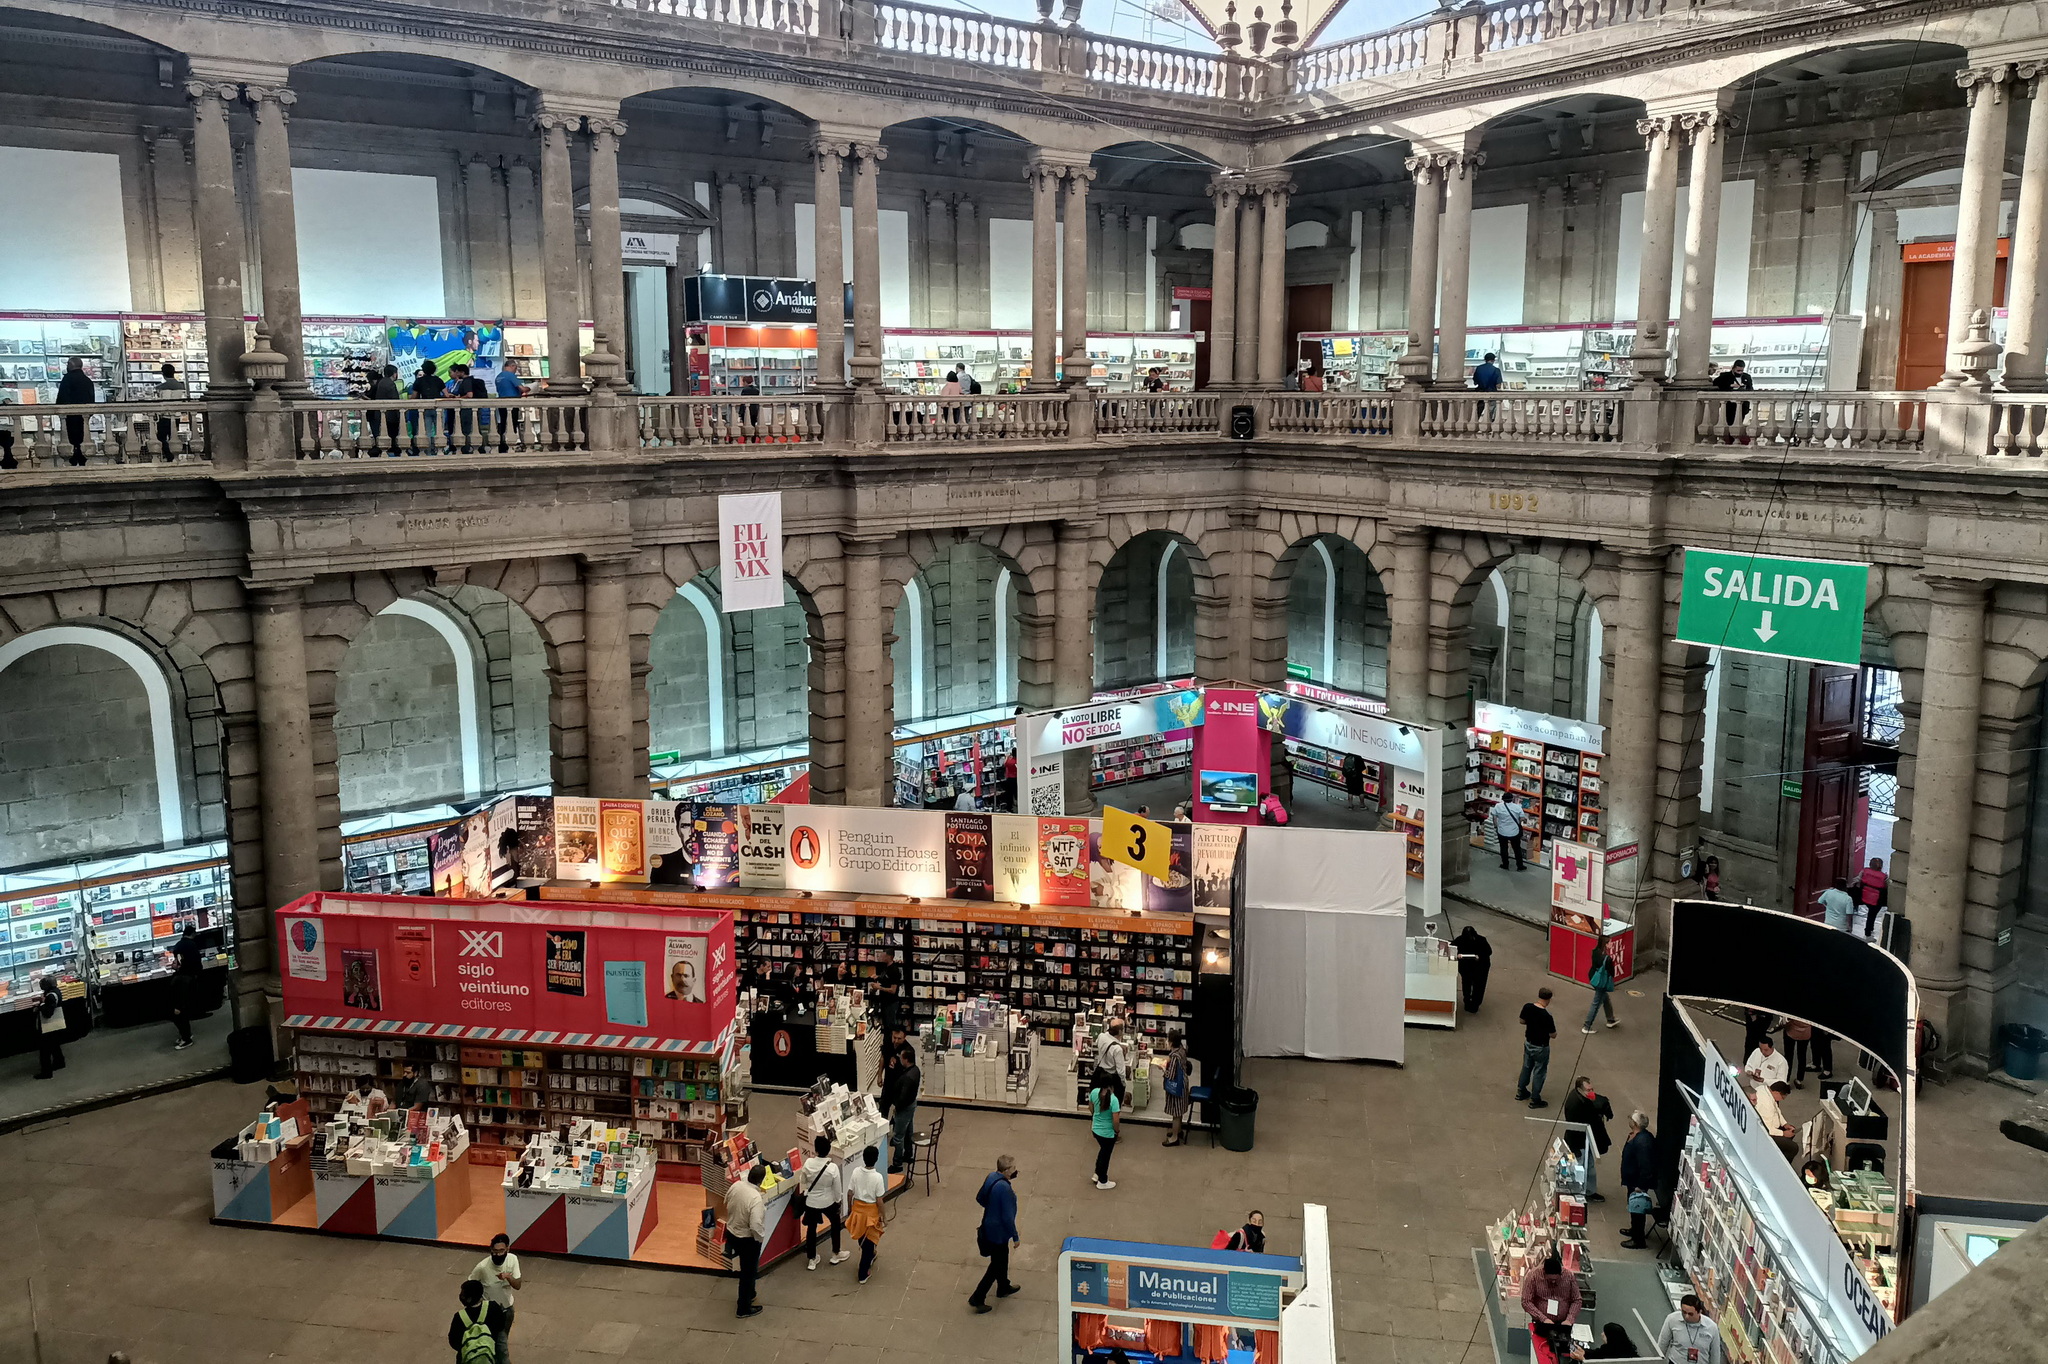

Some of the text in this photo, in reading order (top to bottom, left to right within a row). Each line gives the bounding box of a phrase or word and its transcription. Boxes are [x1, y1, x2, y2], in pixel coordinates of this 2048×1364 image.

[776, 290, 817, 306] Anáhua
[397, 357, 417, 368] SALVAR
[1489, 493, 1538, 512] 1992
[1796, 512, 1808, 521] DE
[733, 523, 768, 542] FIL
[734, 541, 766, 560] PM
[734, 559, 771, 578] MX
[1702, 566, 1839, 611] SALIDA
[1224, 702, 1254, 712] INE
[1071, 714, 1089, 722] VOTO
[1091, 708, 1121, 724] LIBRE
[1062, 722, 1121, 745] NO SE TOCA
[1334, 724, 1406, 754] MI INE NOS UNE
[1517, 721, 1600, 745] Nos acompañan los
[1039, 763, 1060, 774] INE
[651, 808, 670, 816] ORIBE
[493, 811, 514, 832] LLUVIA
[557, 813, 570, 824] EN
[572, 814, 596, 825] ALTO
[610, 828, 633, 838] QUE
[752, 823, 783, 835] REY
[1011, 831, 1019, 840] El
[838, 830, 894, 845] Penguin
[948, 834, 987, 845] ROMA
[1127, 824, 1146, 862] 3
[1197, 835, 1237, 843] ARTURO
[614, 841, 630, 851] YO
[840, 844, 938, 859] Random House
[1000, 842, 1030, 852] infinito
[1052, 841, 1075, 853] WTF
[616, 854, 628, 863] VI
[956, 850, 980, 860] SOY
[1607, 847, 1637, 861] INFORMACIÓN
[839, 857, 941, 873] Grupo Editorial
[1054, 856, 1073, 867] SAT
[960, 865, 977, 876] YO
[1003, 866, 1027, 875] junco
[562, 938, 577, 950] CÓMO
[790, 933, 808, 942] CAJA
[562, 950, 572, 960] ERA
[458, 962, 494, 978] siglo
[548, 959, 581, 972] SER PEQUEÑO
[549, 974, 581, 987] LUIS PESCETTI
[712, 969, 724, 984] siglo
[459, 980, 529, 996] veintiuno
[713, 971, 733, 996] veintiuno
[461, 998, 512, 1012] editores
[714, 989, 728, 1009] editores
[819, 1009, 828, 1018] NO
[1714, 1062, 1747, 1134] OCEANO
[1139, 1270, 1217, 1295] Manual
[1163, 1291, 1217, 1303] Publicaciones
